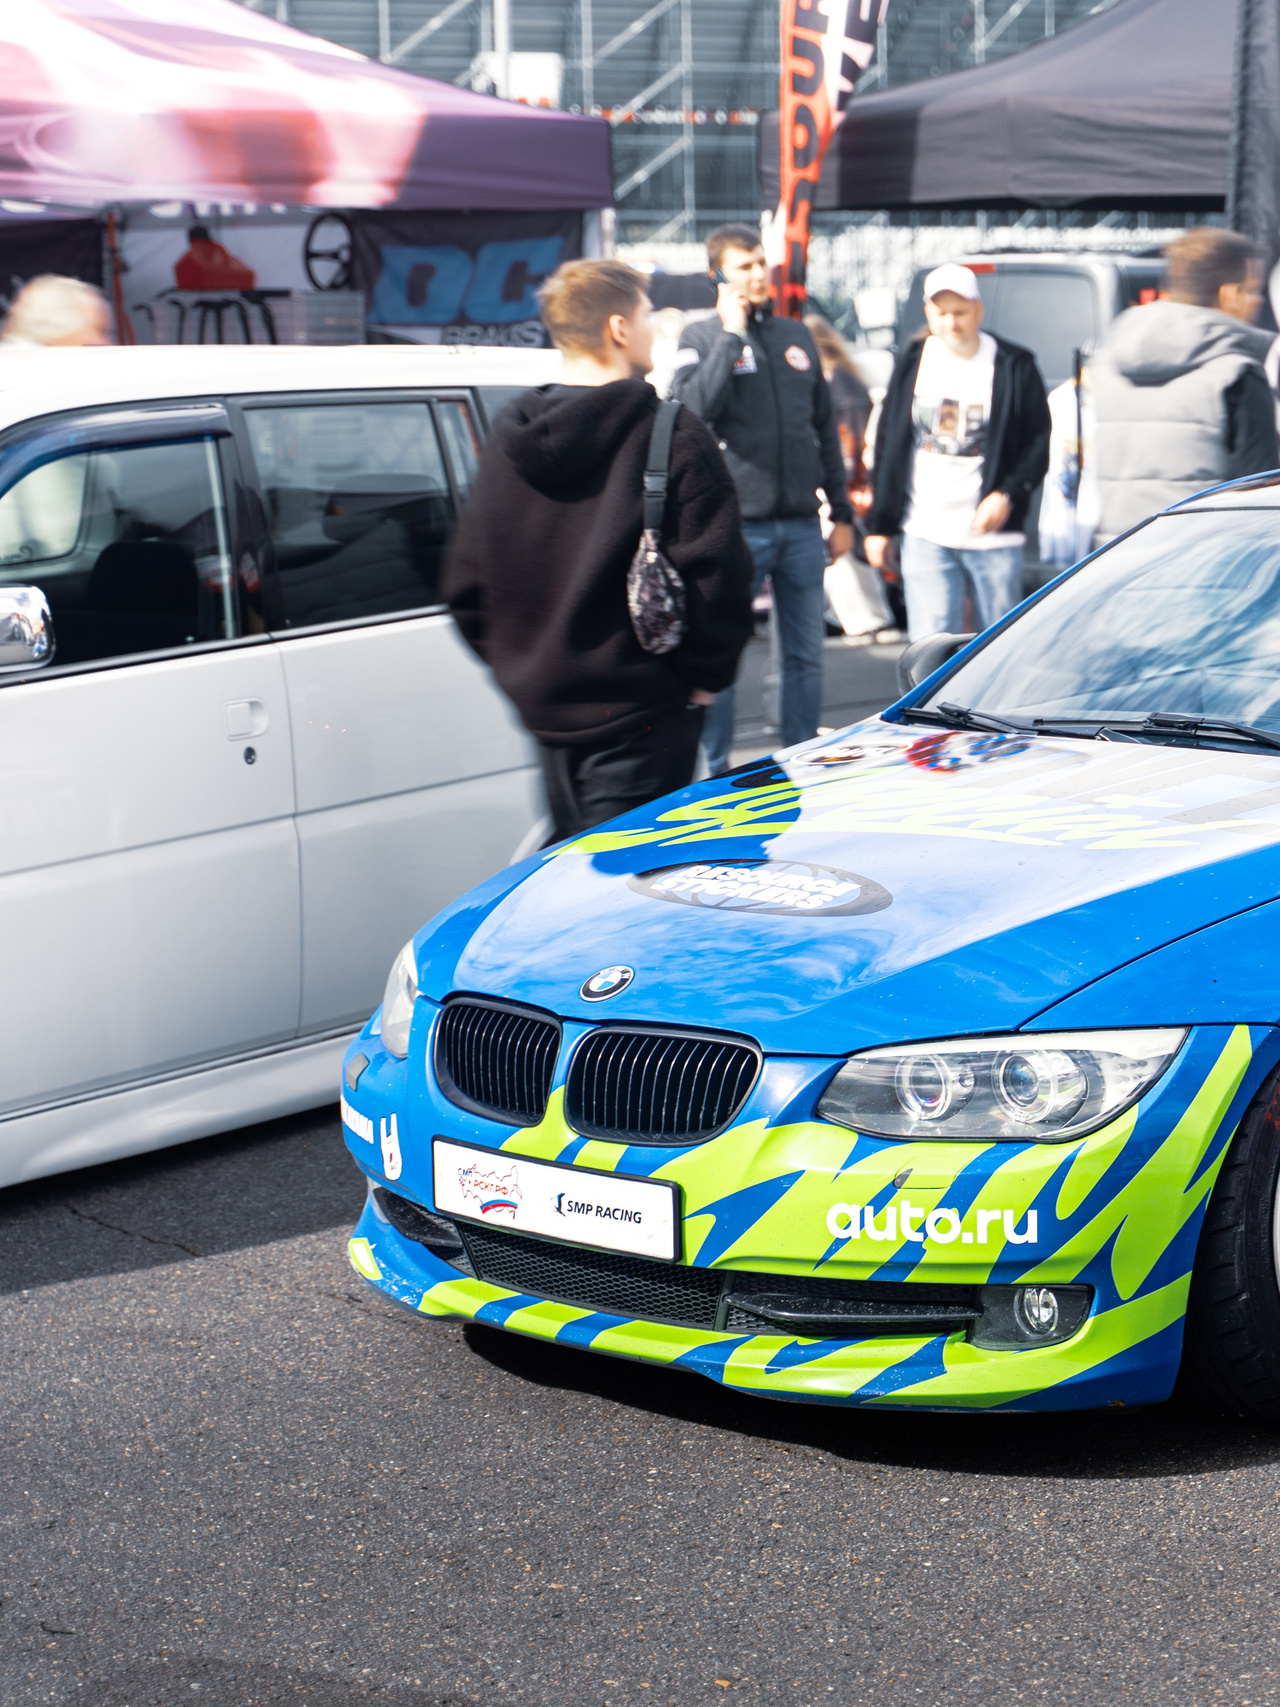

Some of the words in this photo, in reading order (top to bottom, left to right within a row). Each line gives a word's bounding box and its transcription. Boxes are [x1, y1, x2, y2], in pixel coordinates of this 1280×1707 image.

[650, 876, 833, 909] STICKERS
[676, 865, 861, 898] RESOURCE
[567, 1200, 593, 1215] SMP
[596, 1205, 643, 1225] RACING
[826, 1200, 1038, 1245] auto.ru
